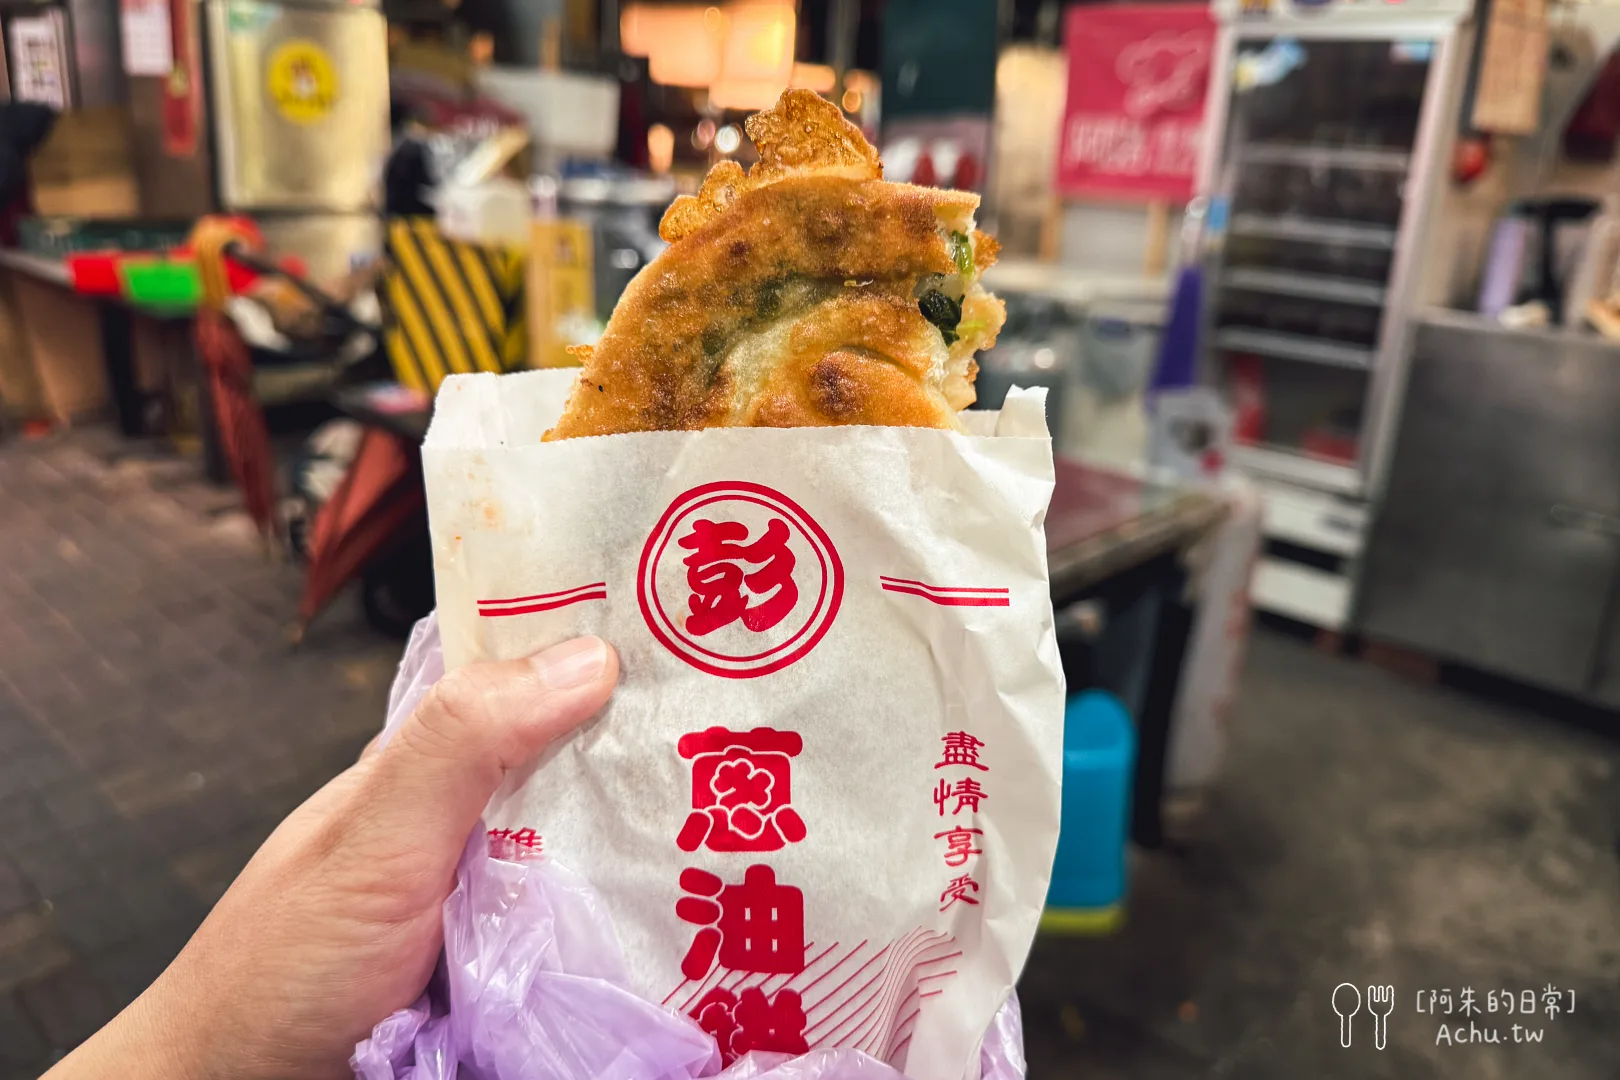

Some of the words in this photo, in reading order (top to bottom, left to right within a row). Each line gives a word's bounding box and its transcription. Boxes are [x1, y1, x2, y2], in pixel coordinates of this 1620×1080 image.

[676, 518, 799, 636] 彭
[934, 730, 989, 911] 盡情享受
